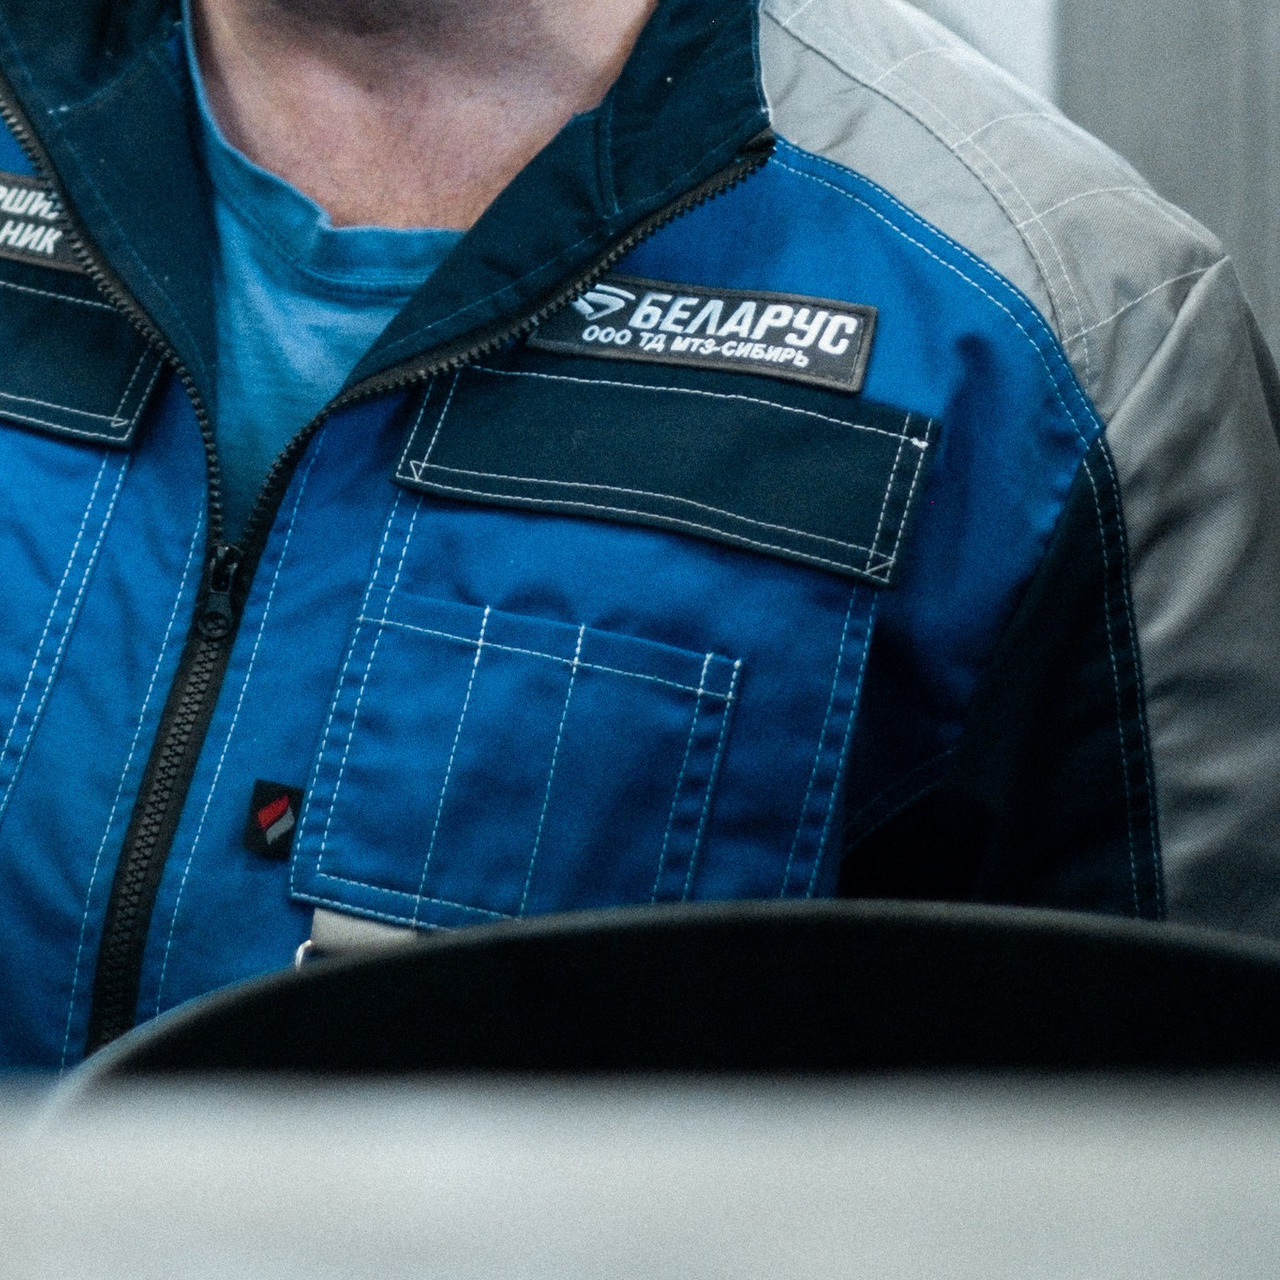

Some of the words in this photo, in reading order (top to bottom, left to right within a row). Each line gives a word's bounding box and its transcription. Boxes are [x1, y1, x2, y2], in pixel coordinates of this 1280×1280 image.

[581, 324, 633, 346] ООО
[669, 335, 810, 369] МТЗ-СИБИРЬ
[628, 291, 858, 356] БЕЛАРУС
